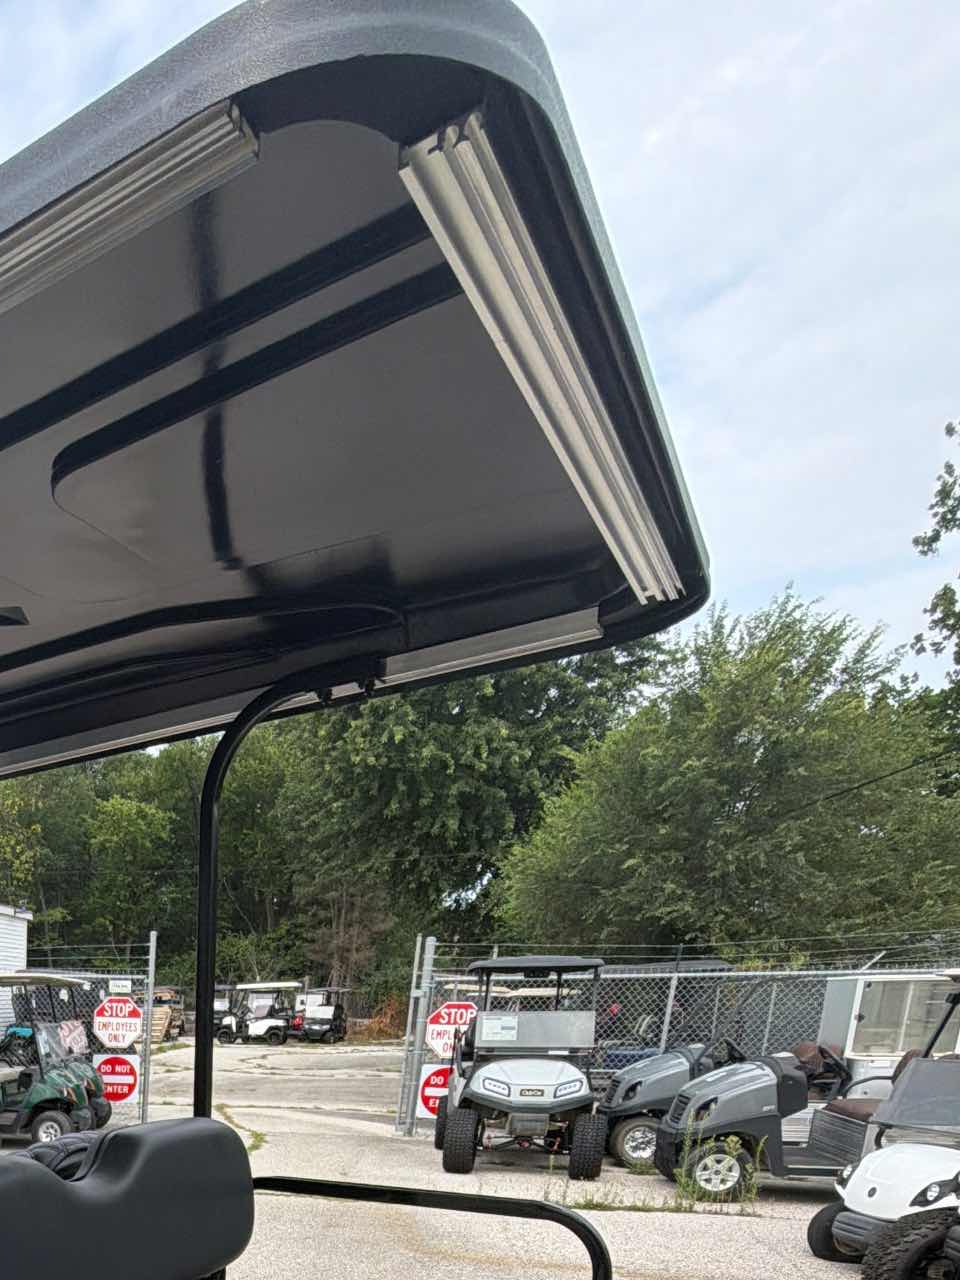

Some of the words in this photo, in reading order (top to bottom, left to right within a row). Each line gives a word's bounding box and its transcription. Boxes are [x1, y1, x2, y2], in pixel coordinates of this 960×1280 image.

[103, 1003, 133, 1017] STOP
[440, 1008, 477, 1024] STOP
[97, 1020, 138, 1032] EMPLOYEES
[108, 1032, 126, 1043] ONLY
[100, 1064, 112, 1073] DO
[115, 1064, 131, 1073] NOT
[430, 1075, 445, 1085] DO
